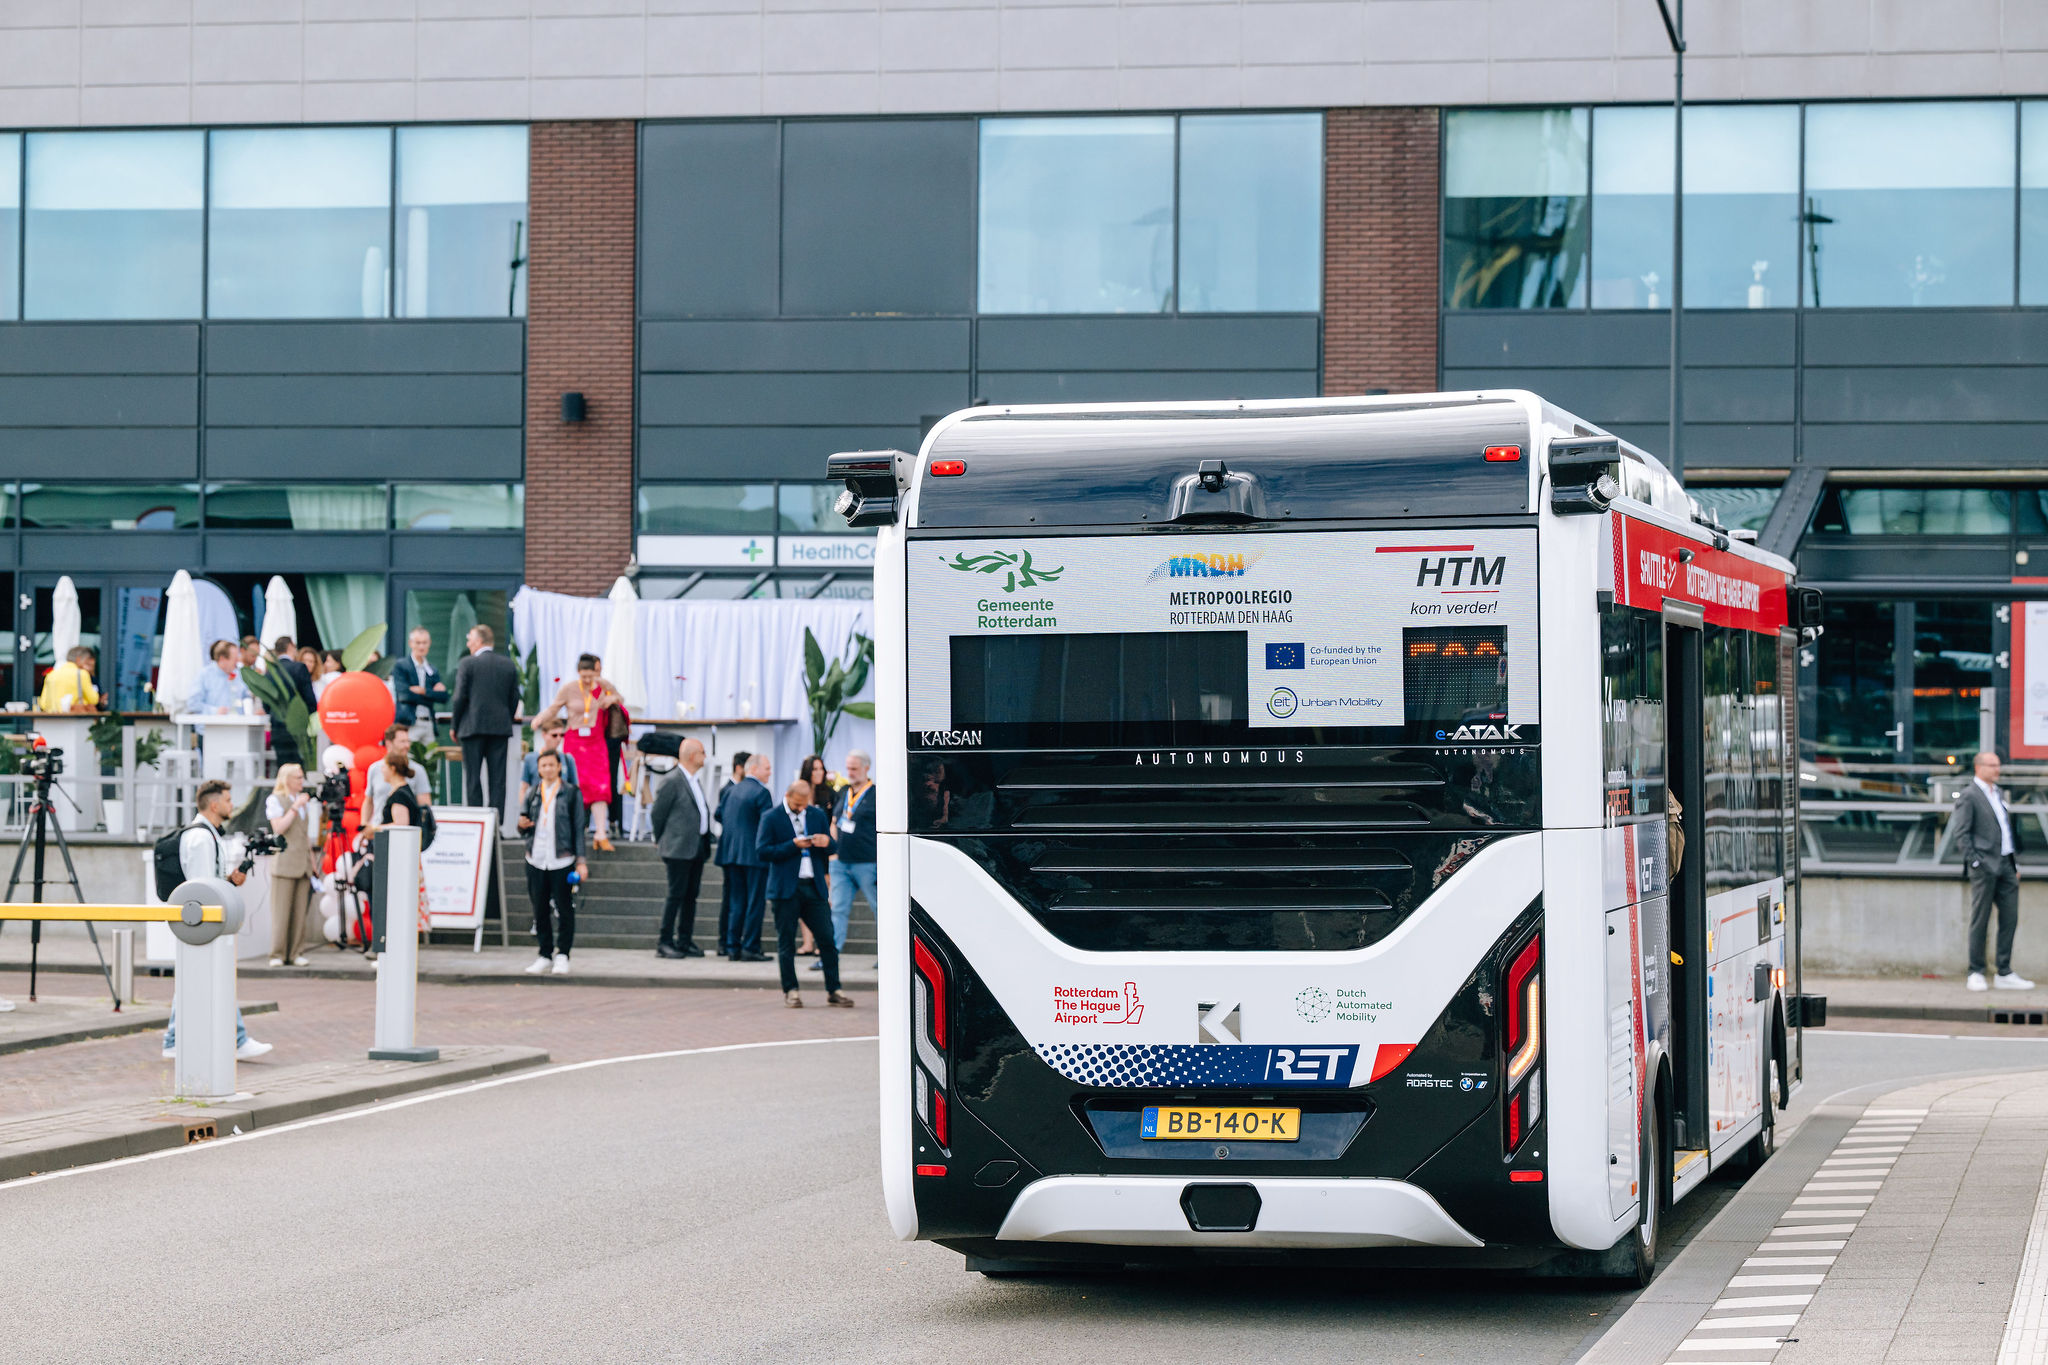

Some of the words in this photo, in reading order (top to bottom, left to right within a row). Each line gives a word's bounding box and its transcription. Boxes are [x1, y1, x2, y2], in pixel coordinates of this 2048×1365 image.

[1169, 553, 1245, 577] MRDH
[1416, 556, 1506, 586] HTM
[1640, 550, 1666, 589] SHUTTLE
[1170, 590, 1292, 605] METROPOOLREGIO
[977, 598, 1054, 612] Gemeente
[1410, 602, 1441, 615] kom
[1447, 601, 1498, 614] verder!
[977, 614, 1057, 628] Rotterdam
[1170, 611, 1235, 625] ROTTERDAM
[1238, 610, 1259, 624] DEN
[1263, 609, 1293, 623] HAAG
[1310, 646, 1353, 655] Co-funded
[1355, 646, 1366, 656] by
[1367, 645, 1382, 654] the
[1310, 657, 1350, 667] European
[1352, 656, 1377, 665] Union
[1274, 696, 1290, 707] eit
[1301, 698, 1337, 707] Urban
[1339, 697, 1383, 708] Mobility
[921, 730, 982, 746] KARSAN
[1135, 750, 1304, 766] AUTONOMOUS
[1435, 748, 1525, 756] AUTONOMOUS
[1054, 986, 1118, 998] Rotterdam
[1336, 989, 1367, 998] Dutch
[1054, 999, 1077, 1011] The
[1080, 1000, 1121, 1014] Hague
[1336, 1001, 1392, 1010] Automated
[1054, 1012, 1098, 1026] Airport
[1336, 1012, 1377, 1023] Mobility
[1275, 1049, 1349, 1081] RET
[1144, 1125, 1155, 1133] NL
[1168, 1112, 1286, 1134] BB-140-K
